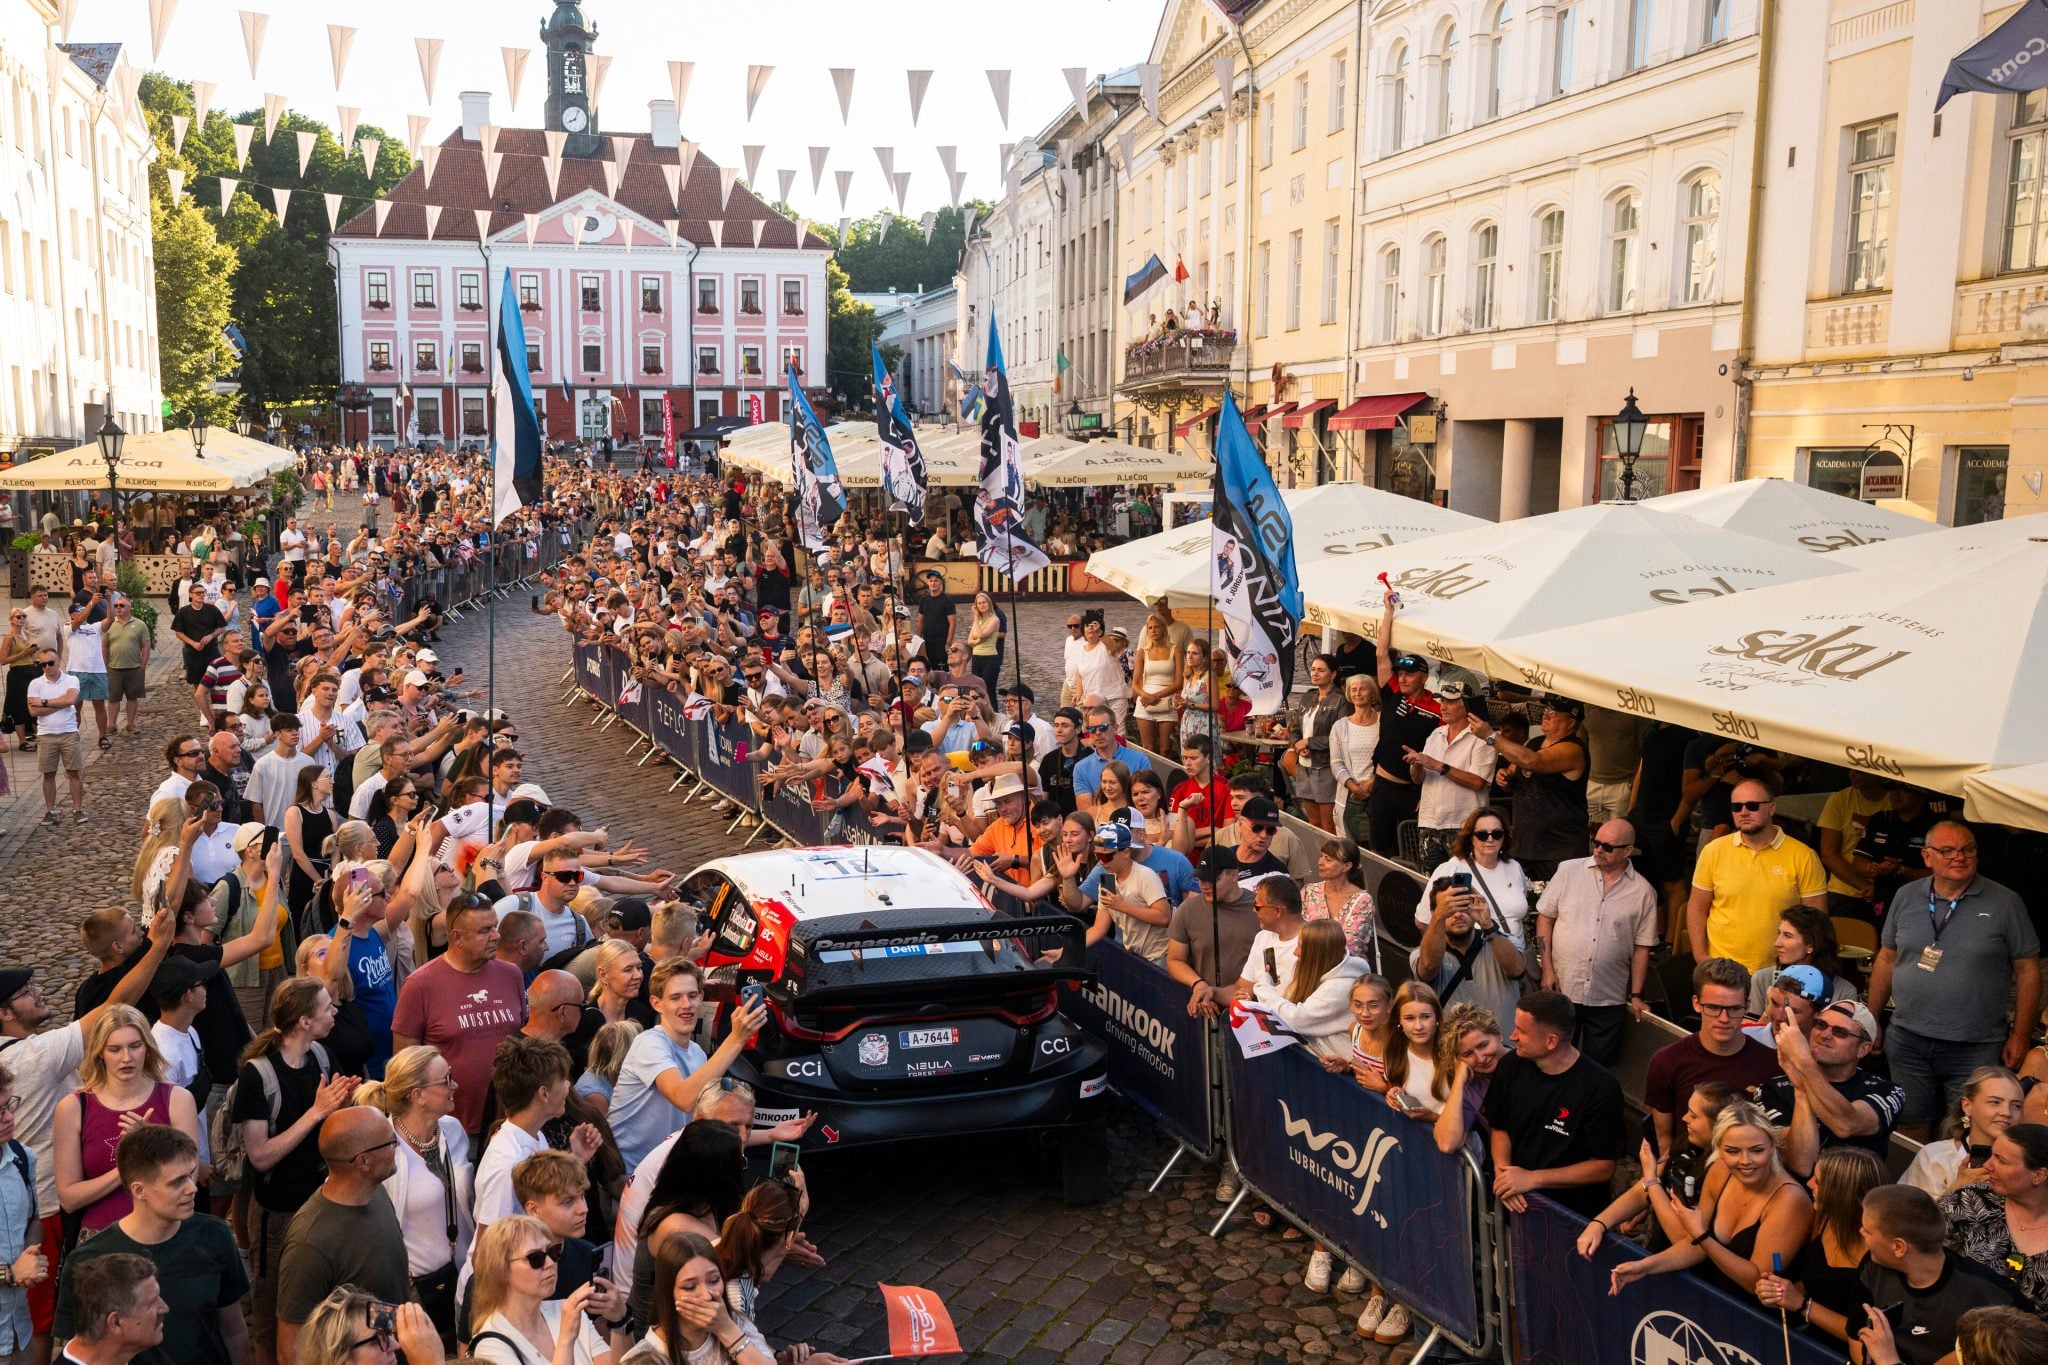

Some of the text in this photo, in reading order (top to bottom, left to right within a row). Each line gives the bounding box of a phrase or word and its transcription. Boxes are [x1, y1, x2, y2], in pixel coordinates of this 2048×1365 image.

[1085, 456, 1164, 466] A.LeCoq
[1815, 460, 1851, 468] ACCADEMIA
[2, 478, 36, 488] A.LeCoq
[64, 478, 97, 487] A.LeCoq
[125, 478, 158, 487] A.LeCoq
[186, 479, 218, 488] A.LeCoq
[847, 476, 879, 485] A.LeCoq
[1056, 475, 1087, 484] A.LeCoq
[1116, 473, 1148, 482] A.LeCoq
[1309, 605, 1331, 626] saku
[1426, 637, 1455, 663] saku
[1706, 625, 1912, 682] saku
[1519, 663, 1555, 690] saku
[1616, 686, 1656, 716] saku
[1711, 711, 1760, 741] saku
[1845, 744, 1905, 778] saku
[814, 931, 940, 951] Panasonic
[946, 924, 1074, 942] AUTOMOTIVE
[457, 1008, 515, 1029] MUSTANG
[912, 1031, 950, 1045] A-7644
[1105, 1018, 1176, 1081] driving emotion
[1288, 1145, 1356, 1202] LUBRICANTS
